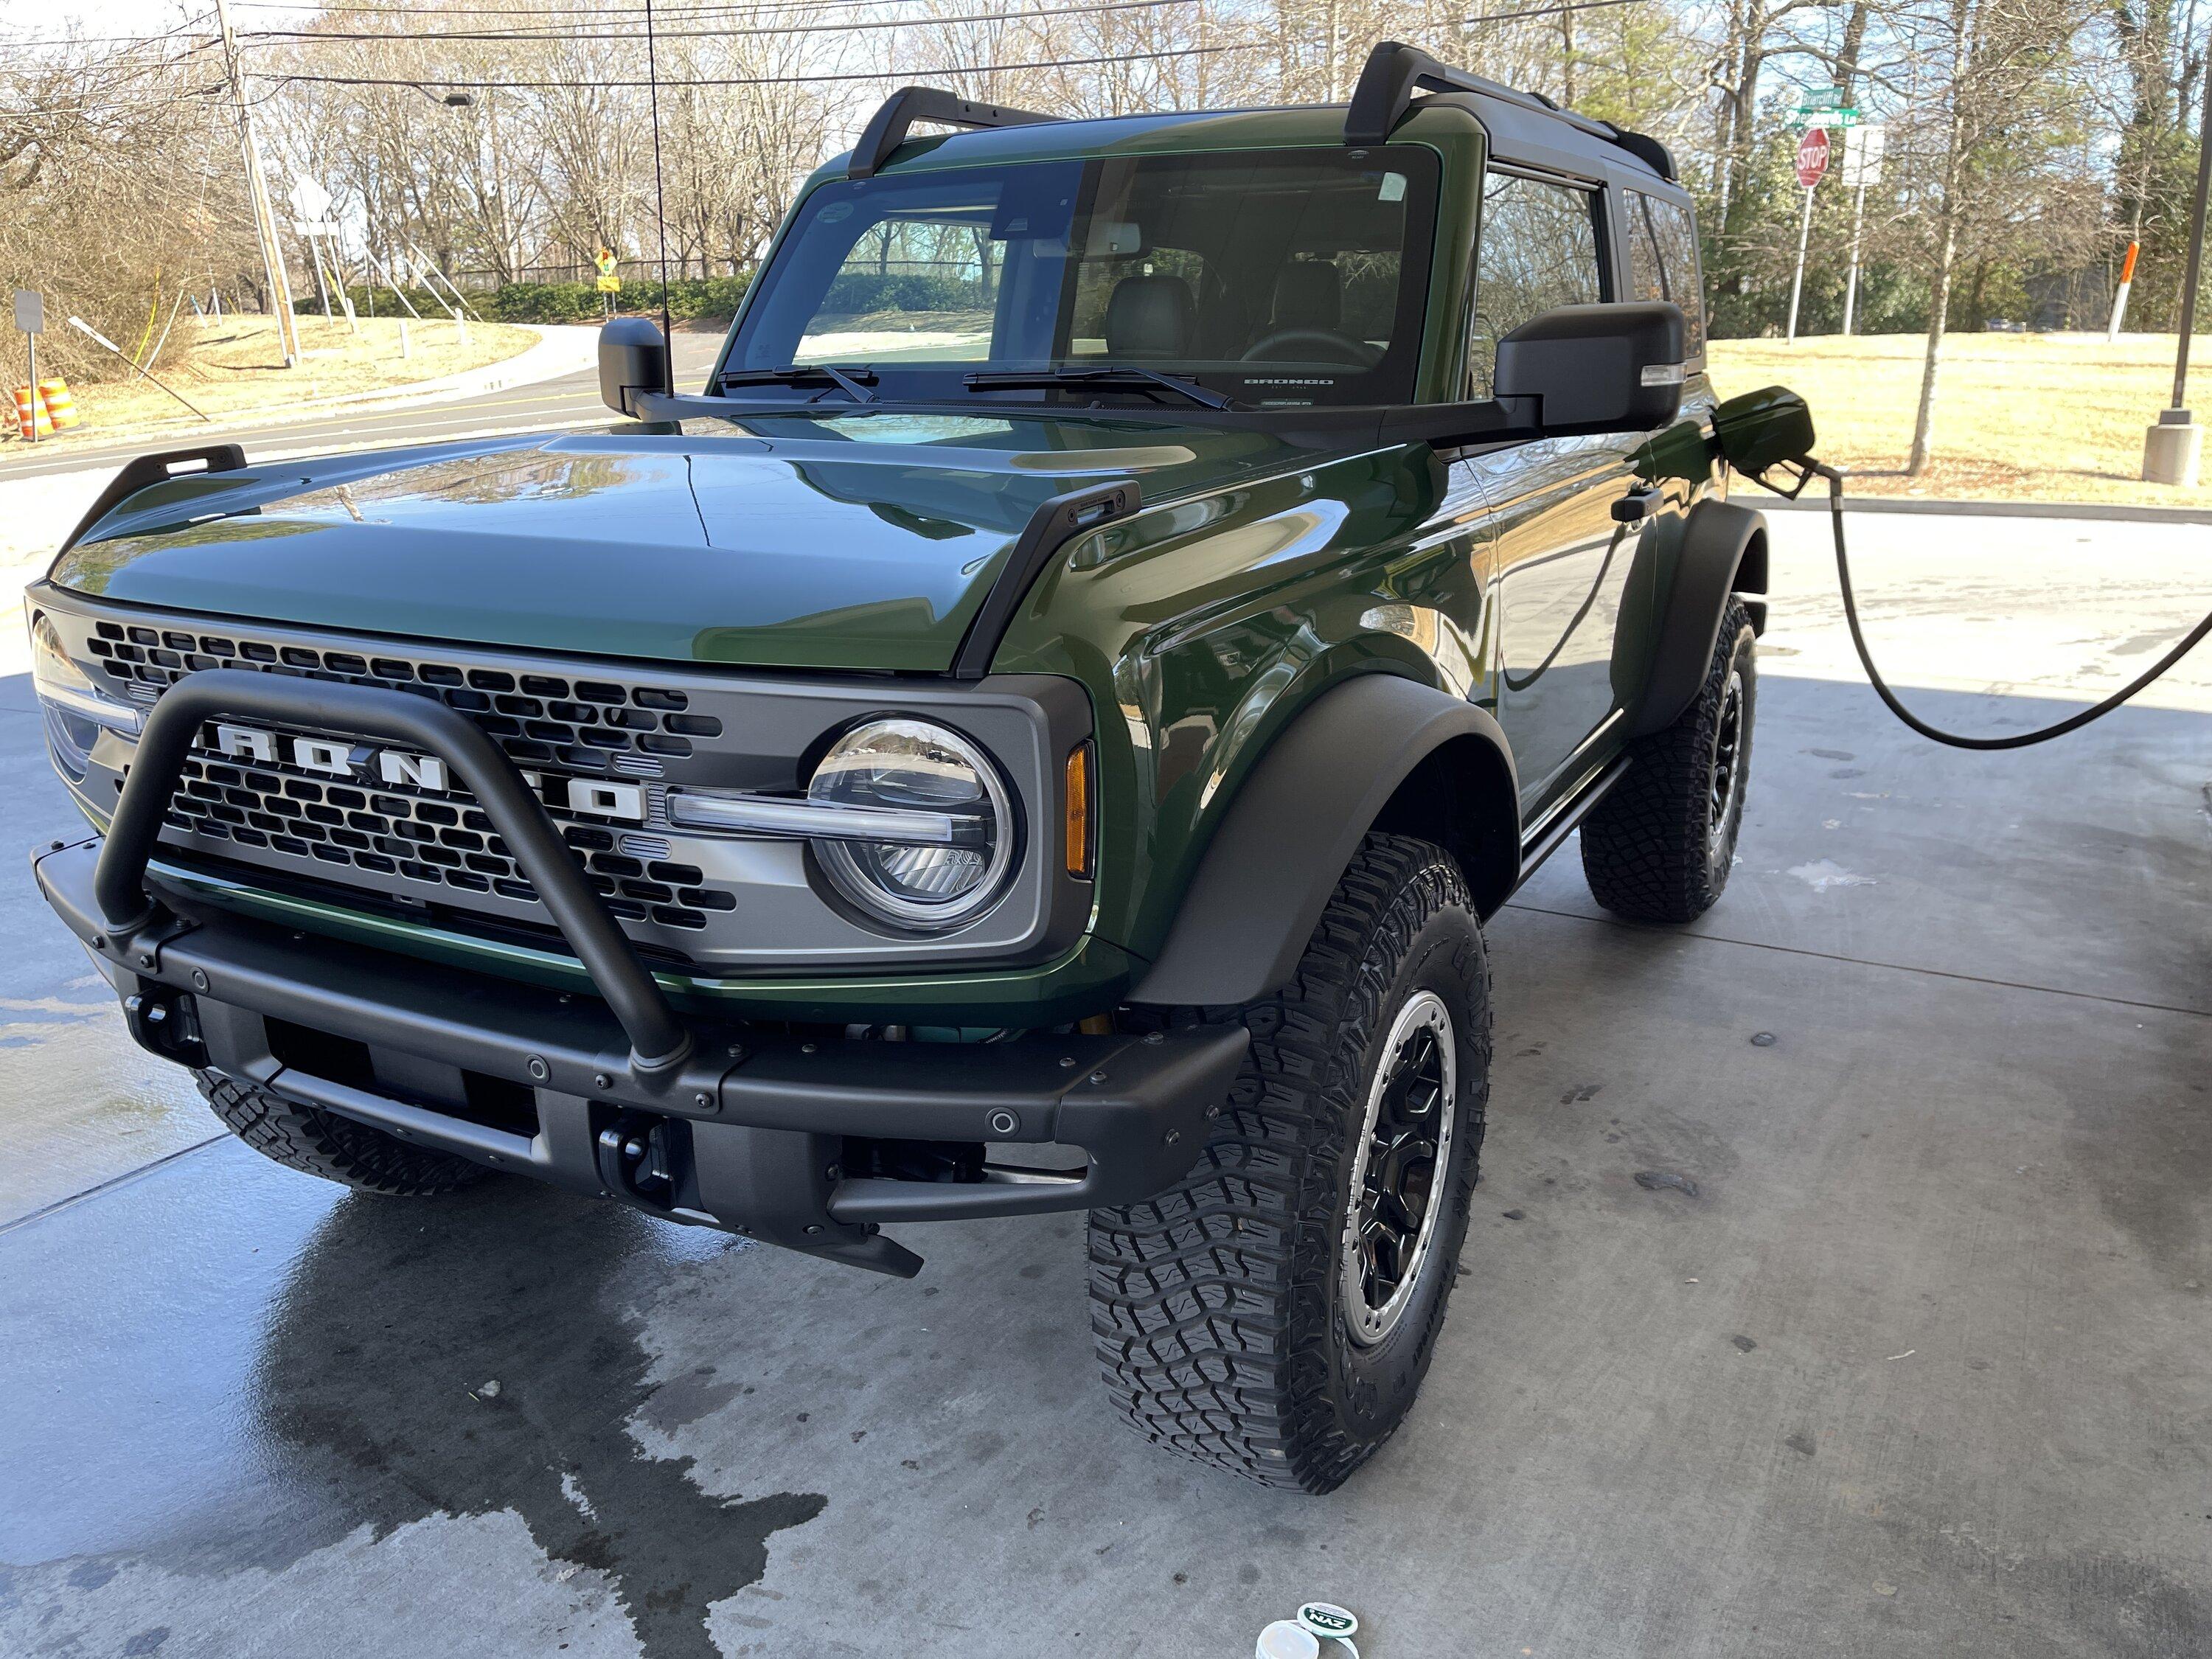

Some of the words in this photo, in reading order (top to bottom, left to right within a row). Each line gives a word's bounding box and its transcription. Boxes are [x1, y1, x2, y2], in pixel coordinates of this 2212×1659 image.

[1803, 91, 1834, 105] Briarcliff
[1834, 94, 1842, 105] Rd
[1784, 109, 1843, 125] Shepds
[1844, 114, 1857, 124] Ln
[1799, 145, 1828, 170] STOP
[190, 723, 650, 821] RONO
[1452, 935, 1489, 1218] GOODYEAR
[1309, 1613, 1346, 1629] ZYN
